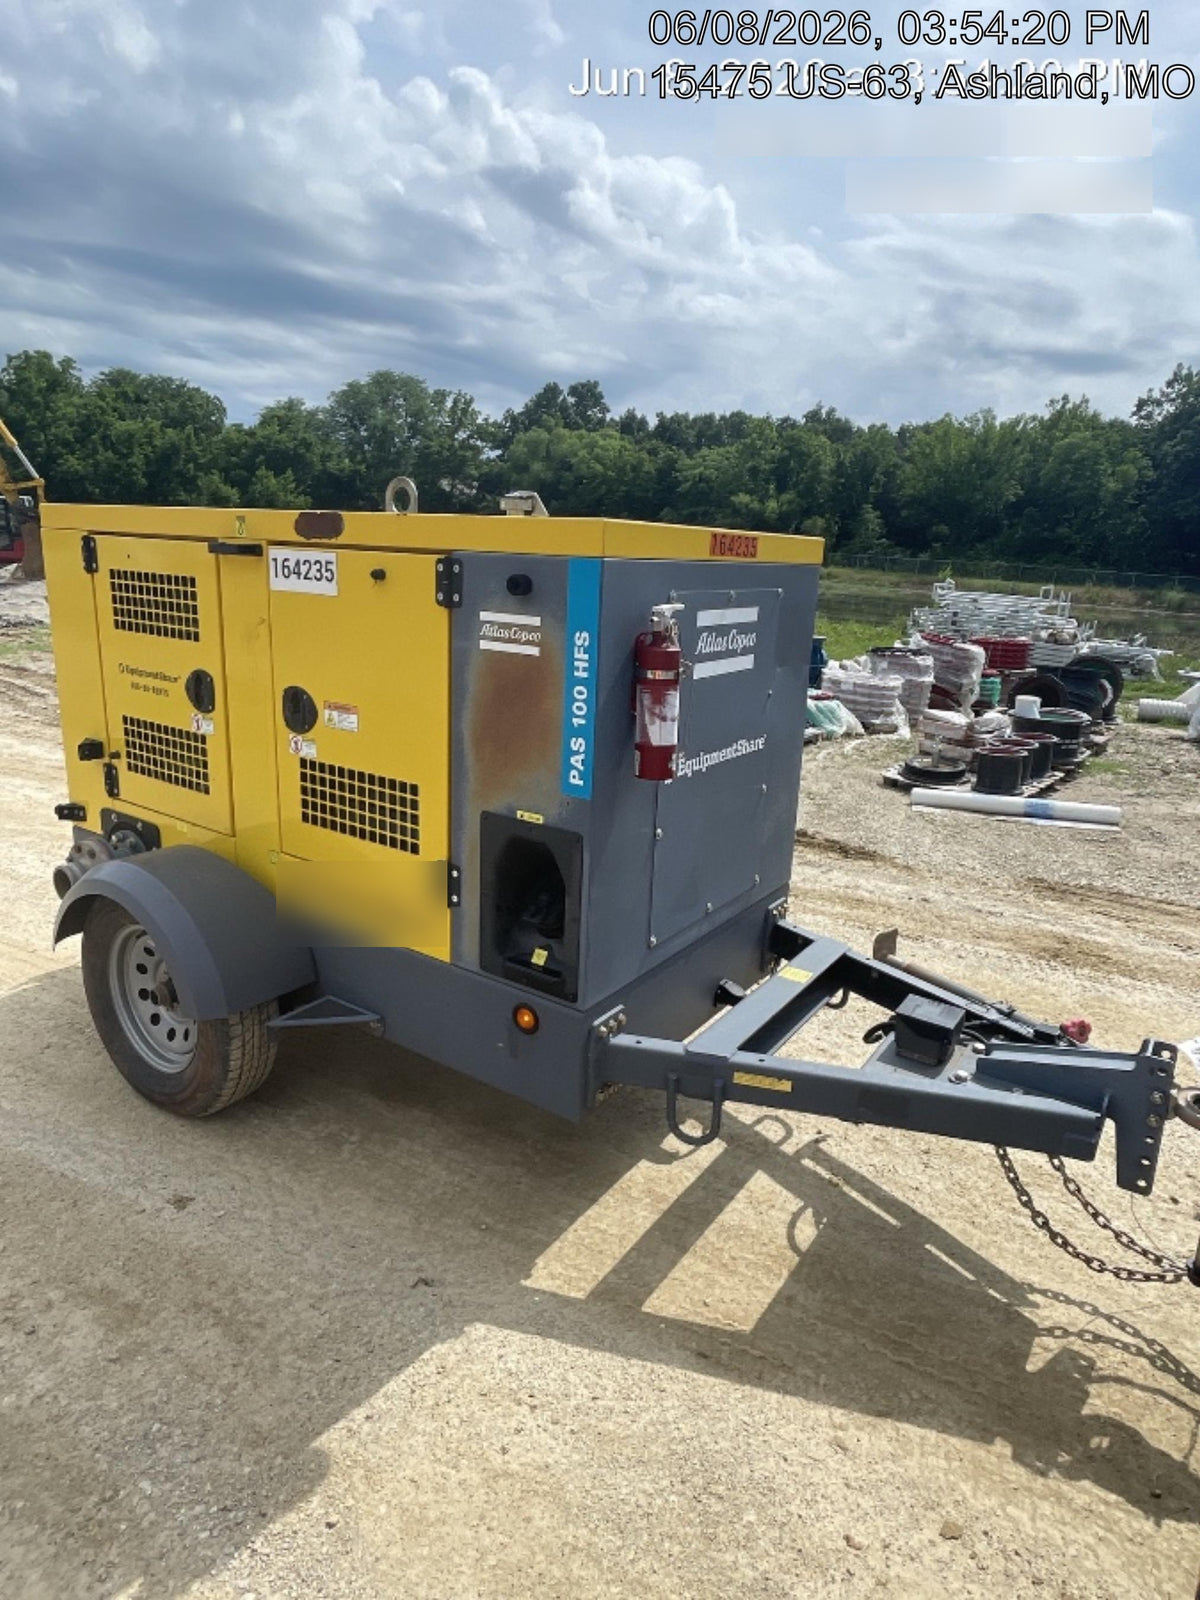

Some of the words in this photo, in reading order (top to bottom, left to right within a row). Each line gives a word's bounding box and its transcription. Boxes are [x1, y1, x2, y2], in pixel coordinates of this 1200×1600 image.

[712, 533, 758, 559] 164235
[271, 557, 335, 582] 164235
[480, 623, 510, 639] Atlas
[510, 627, 541, 642] Copco
[694, 631, 728, 655] Atlas
[728, 629, 757, 653] Copco
[573, 630, 590, 679] HFS
[571, 685, 588, 728] 100
[568, 737, 586, 787] PAS
[677, 736, 766, 778] EquipmentShare
